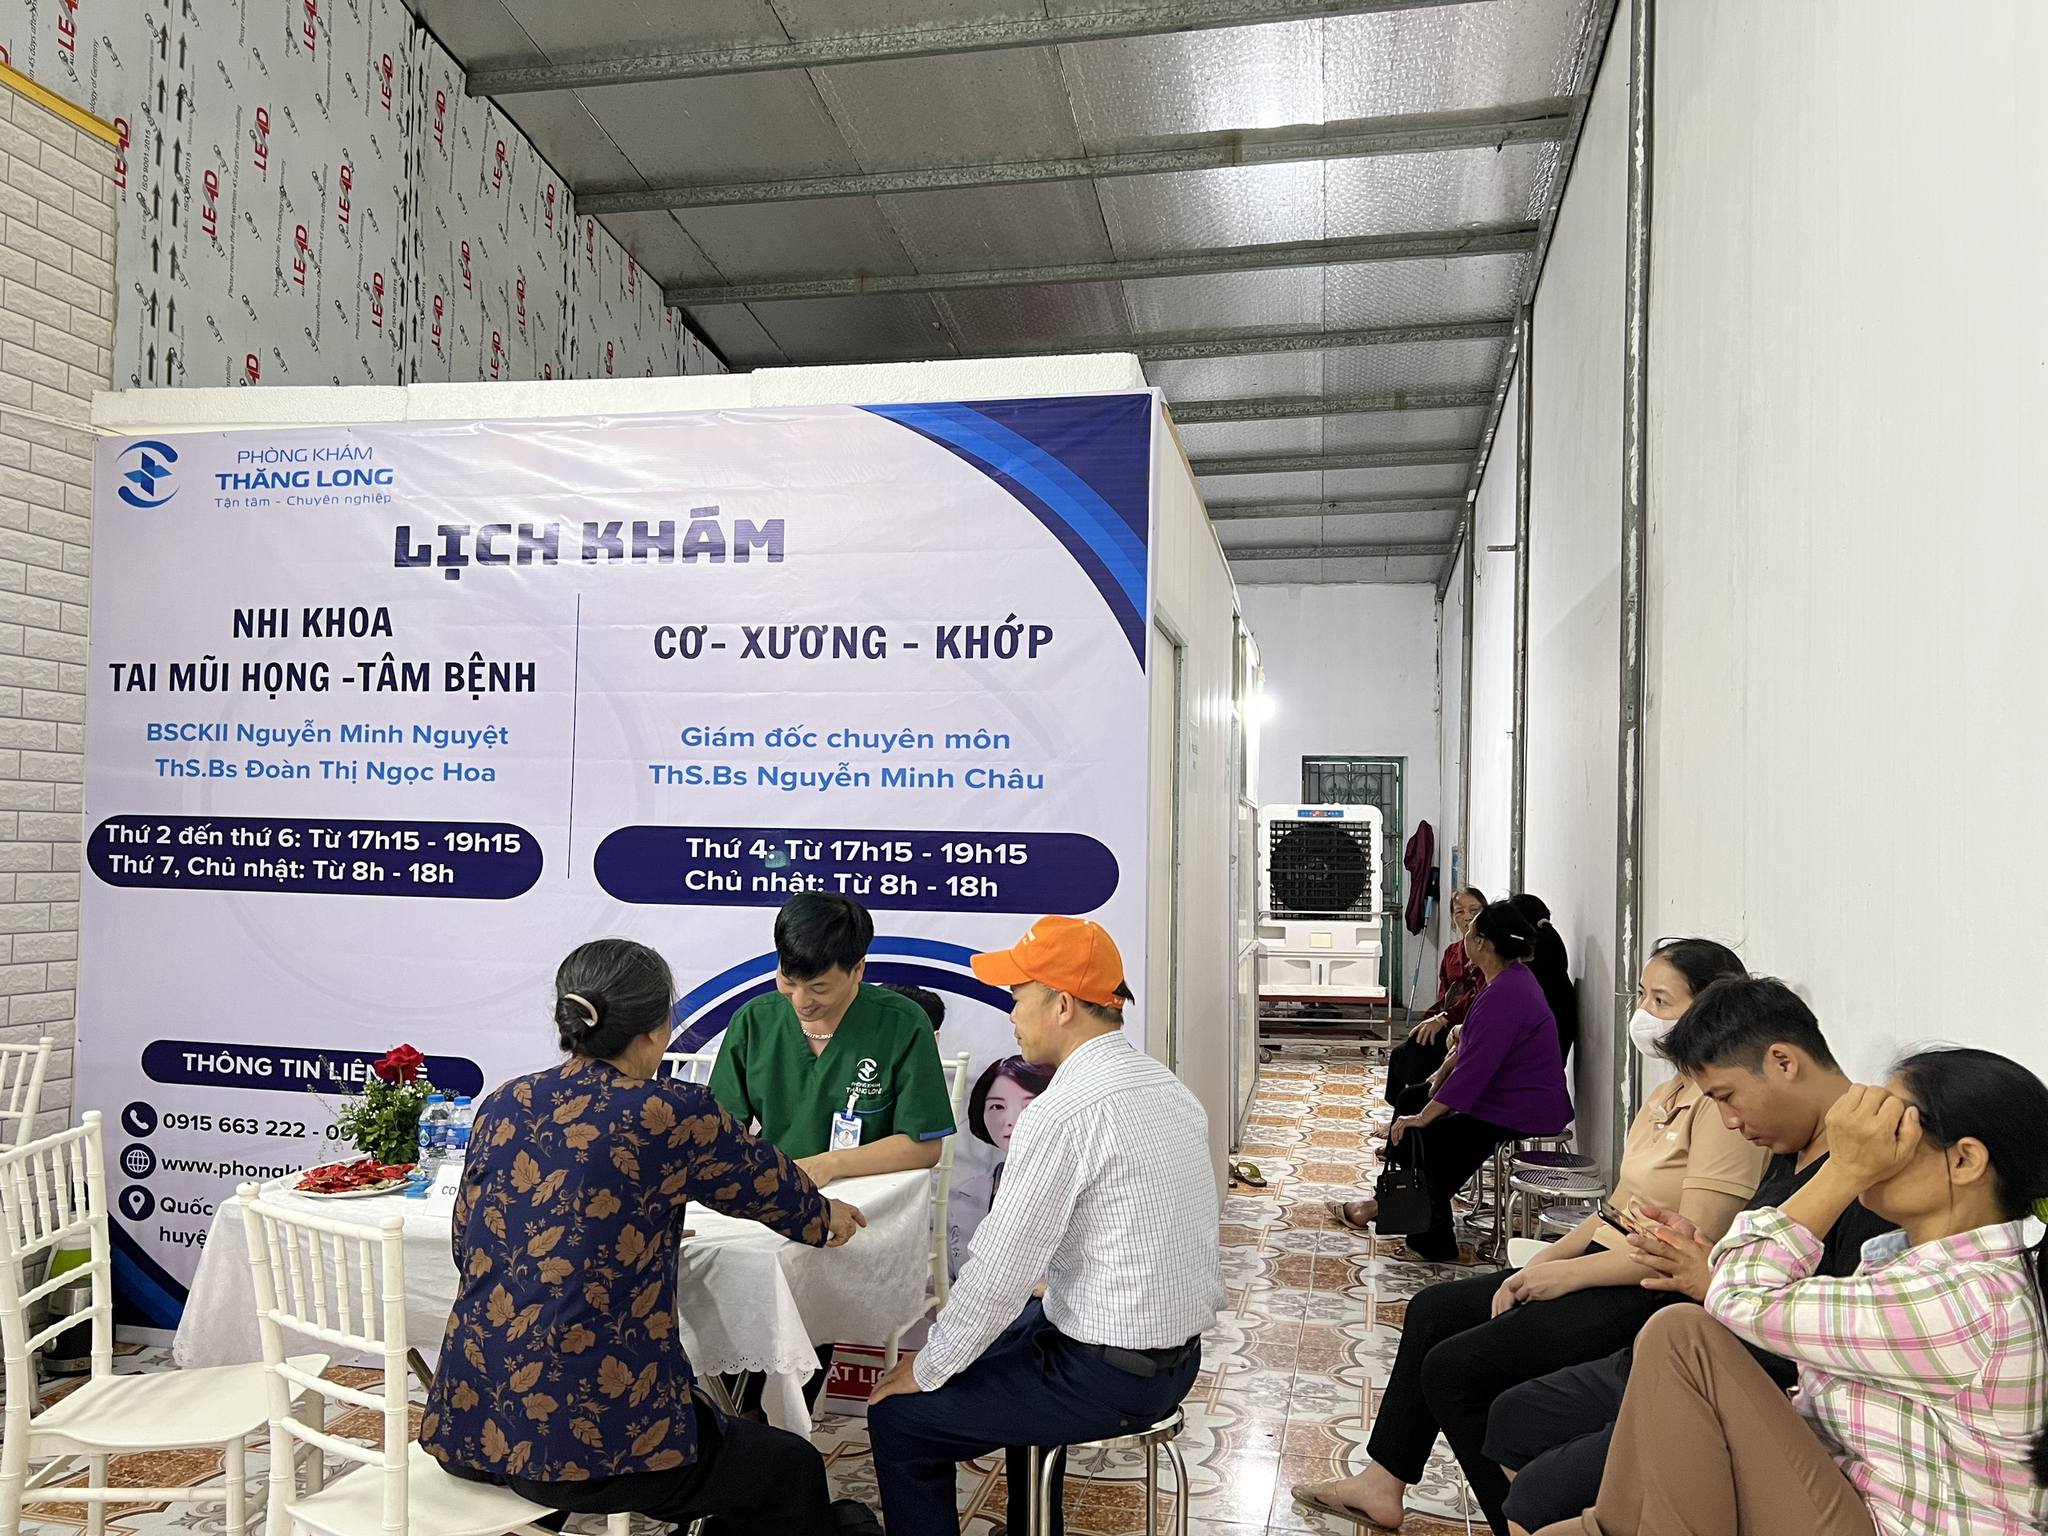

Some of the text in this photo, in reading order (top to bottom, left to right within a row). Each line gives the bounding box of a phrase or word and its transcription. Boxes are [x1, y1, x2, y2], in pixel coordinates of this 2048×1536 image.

[58, 0, 78, 52] LEA
[303, 0, 317, 50] LEA
[237, 444, 373, 464] PHÒNG KHÁM
[215, 468, 394, 490] THĂNG LONG
[215, 497, 241, 509] Tận
[246, 494, 271, 507] tâm
[287, 493, 339, 507] Chuyên
[345, 492, 392, 507] nghiệp
[394, 505, 785, 581] LỊCH KHÁM
[233, 606, 394, 639] NHI KHOA
[739, 624, 888, 660] XƯƠNG
[935, 612, 1054, 660] KHỚP
[109, 663, 156, 692] TAI
[169, 655, 229, 692] MŨI
[242, 662, 330, 700] HỌNG
[444, 651, 536, 701] BỆNH
[237, 719, 331, 749] Nguyễn
[340, 723, 404, 744] Minh
[413, 724, 509, 749] Nguyệt
[680, 724, 1011, 754] Giám đốc chuyên môn
[155, 757, 496, 786] ThS.Bs Đoàn Thị Ngọc Hoa
[649, 761, 1045, 792] ThS.Bs Nguyễn Minh Châu
[105, 823, 151, 845] Thứ
[156, 827, 171, 844] 2
[178, 824, 223, 847] đến
[230, 827, 272, 848] thứ
[278, 829, 301, 849] 6:
[308, 827, 341, 850] Từ
[347, 829, 420, 851] 17h15
[443, 832, 522, 854] 19h15
[686, 836, 743, 860] Thứ
[748, 838, 777, 861] 4:
[784, 837, 823, 862] Từ
[829, 840, 914, 864] 17h15
[940, 842, 1028, 865] 19h15
[109, 854, 154, 876] Thứ
[159, 856, 180, 879] 7,
[187, 854, 236, 879] Chủ
[244, 856, 306, 882] nhật:
[312, 859, 346, 881] Từ
[351, 861, 385, 882] 8h
[408, 862, 455, 884] 18h
[684, 867, 742, 892] Chủ
[752, 871, 825, 896] nhật:
[833, 871, 871, 895] Từ
[879, 873, 918, 896] 8h
[945, 875, 999, 898] 18h
[182, 1051, 273, 1077] THÔNG
[280, 1059, 320, 1080] TIN
[163, 1112, 212, 1131] 0915
[218, 1117, 259, 1135] 663
[265, 1120, 306, 1139] 222
[161, 1158, 303, 1179] www.phongk
[160, 1196, 213, 1216] Quốc
[159, 1226, 208, 1249] huyệ
[827, 1360, 854, 1383] ẶT
